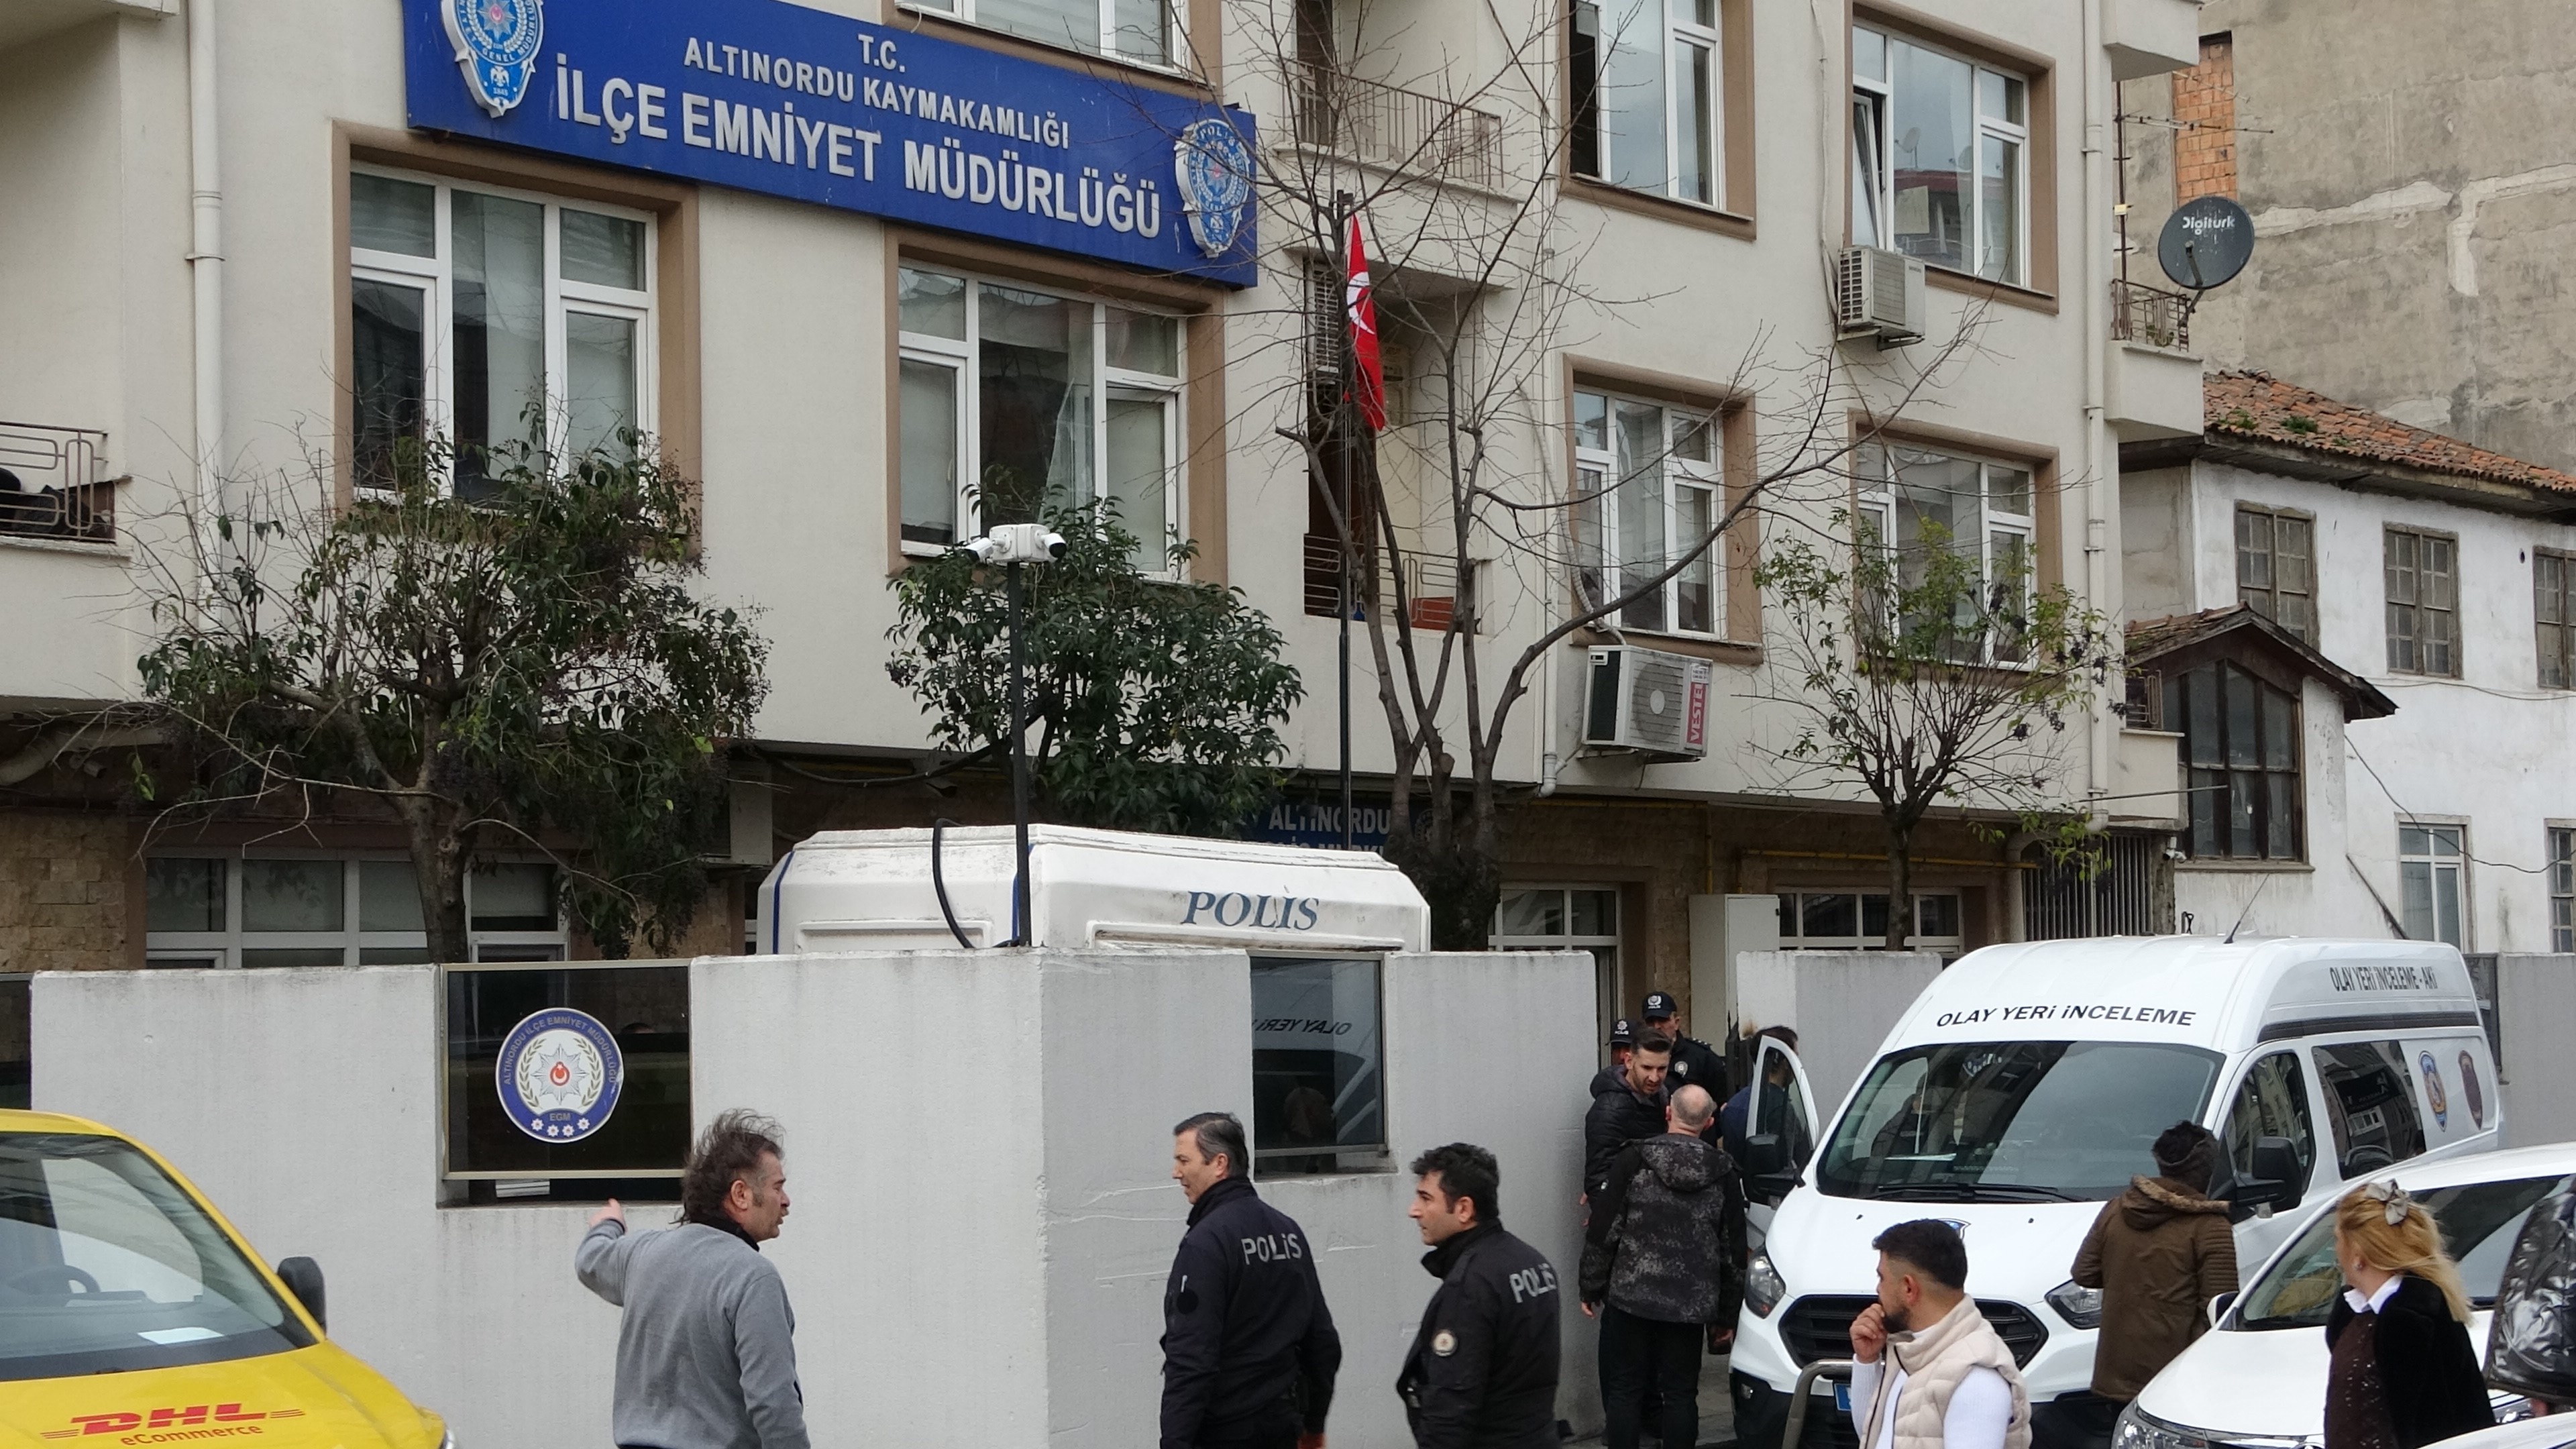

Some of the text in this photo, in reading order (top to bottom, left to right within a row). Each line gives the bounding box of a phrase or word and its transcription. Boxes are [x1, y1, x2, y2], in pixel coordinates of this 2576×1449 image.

[482, 48, 515, 62] GENEL
[858, 34, 905, 72] T.C.
[684, 38, 1069, 149] ALTINORDU KAYMAKAMLIĞI
[557, 52, 668, 144] İLÇE
[682, 92, 882, 182] EMNİYET
[904, 136, 1160, 239] MÜDÜRLÜĞÜ
[2182, 215, 2235, 235] Digiturk
[2330, 967, 2355, 992] OLAY
[1936, 1008, 1998, 1027] OLAY
[504, 1034, 526, 1085] ALTINORDU
[547, 1016, 588, 1030] EMNİYET
[549, 1113, 570, 1121] EGM
[70, 1403, 267, 1436] DHL
[120, 1425, 264, 1446] eCommerce
